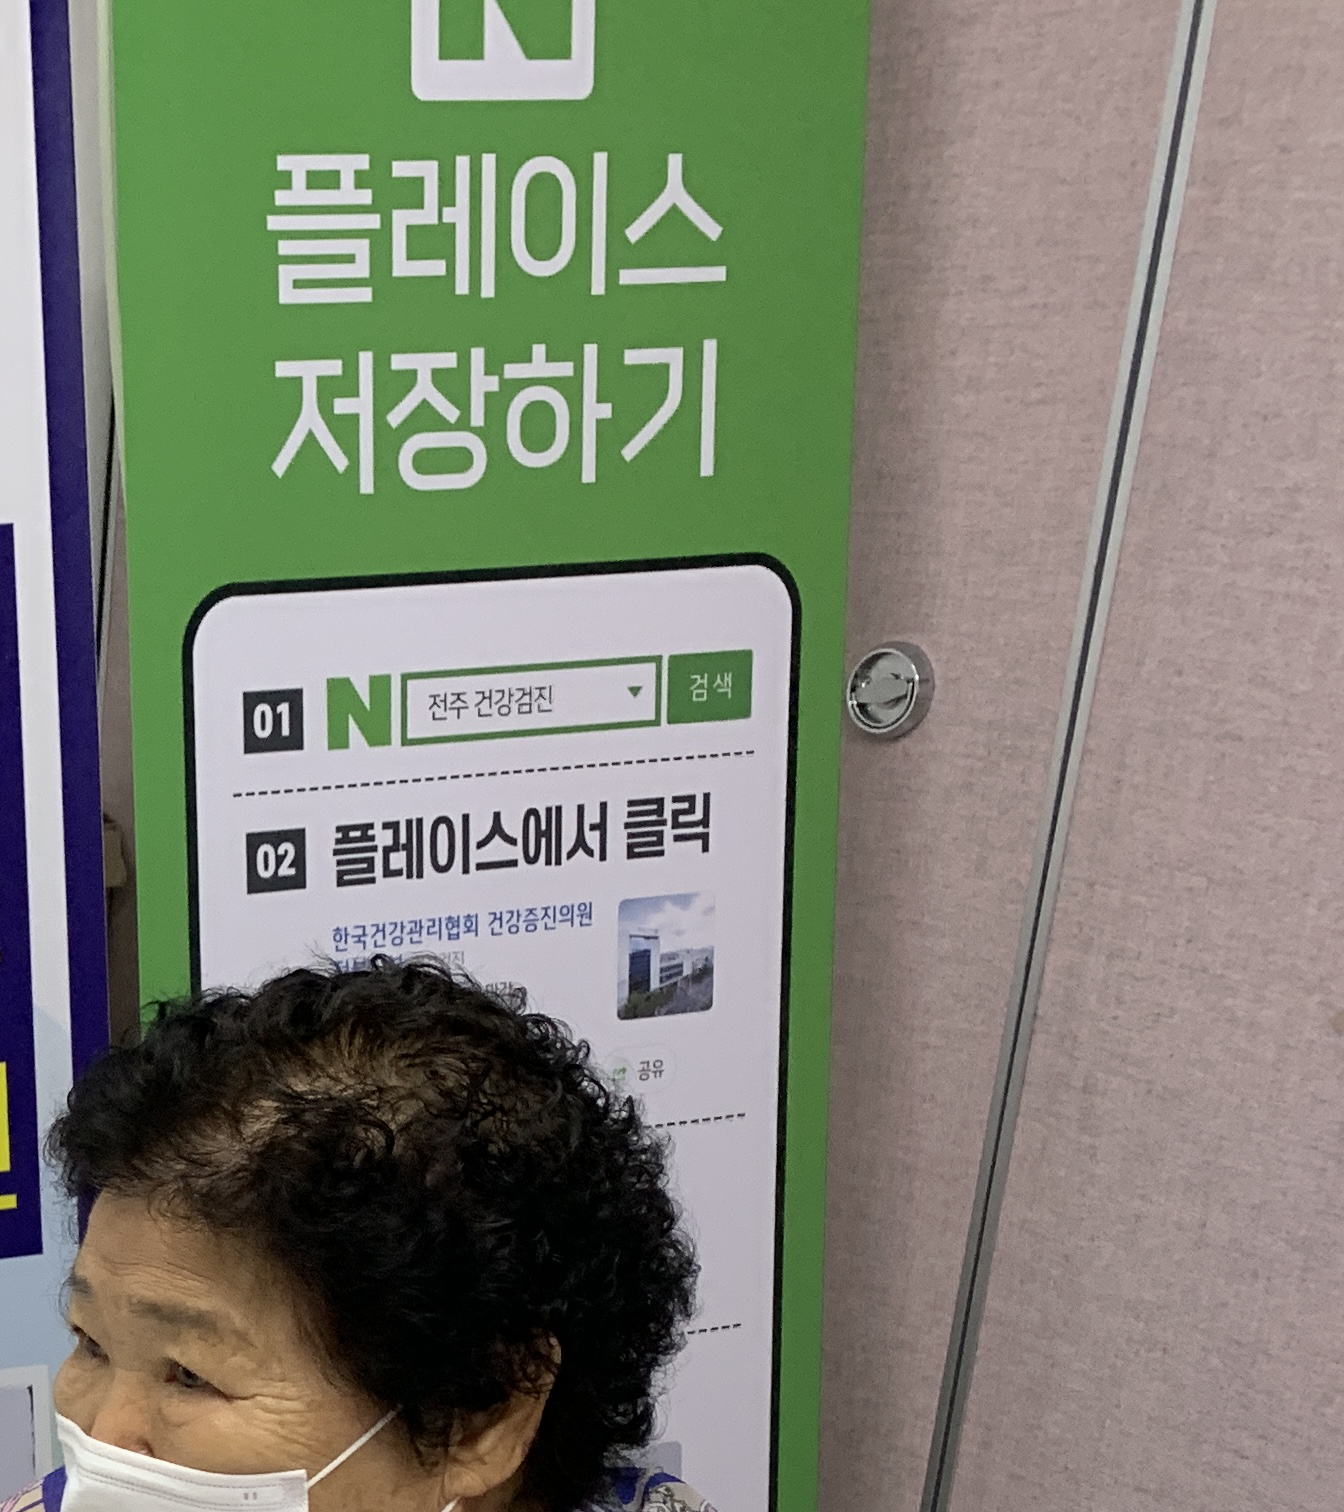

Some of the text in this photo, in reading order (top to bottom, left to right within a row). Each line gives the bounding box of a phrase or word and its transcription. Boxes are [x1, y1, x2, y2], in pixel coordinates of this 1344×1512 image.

[267, 151, 727, 305] 플레이스
[271, 339, 718, 494] 저장하기
[427, 684, 555, 721] 전주 건강검진
[689, 671, 733, 700] 검색
[253, 701, 292, 739] 01
[332, 792, 712, 887] 플레이스에서 클릭
[256, 842, 296, 879] 02
[331, 902, 593, 952] 한국건강관리협회 건강증진의원
[637, 1059, 665, 1081] 공유
